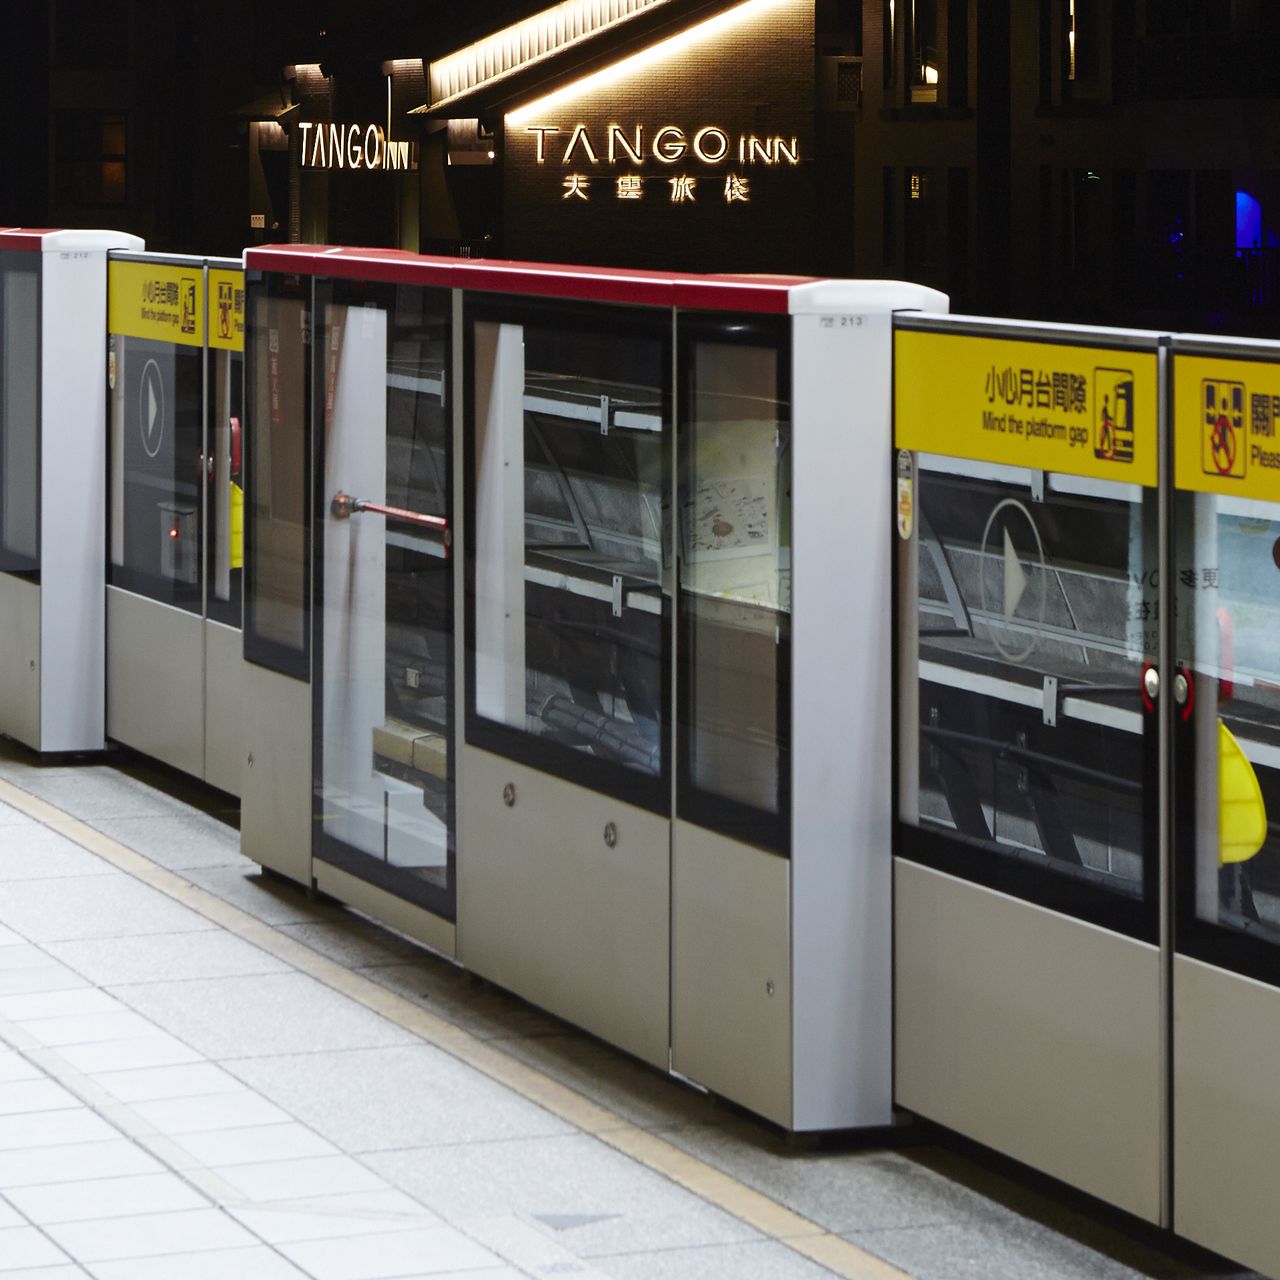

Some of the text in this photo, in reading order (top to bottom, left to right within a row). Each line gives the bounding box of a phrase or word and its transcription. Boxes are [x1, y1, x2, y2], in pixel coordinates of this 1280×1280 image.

[299, 122, 410, 170] TANGO INN
[527, 124, 799, 165] TANGO INN
[841, 317, 862, 327] 213
[985, 365, 1087, 414] 小心月台間隙
[982, 410, 1089, 448] Mind the platform gap
